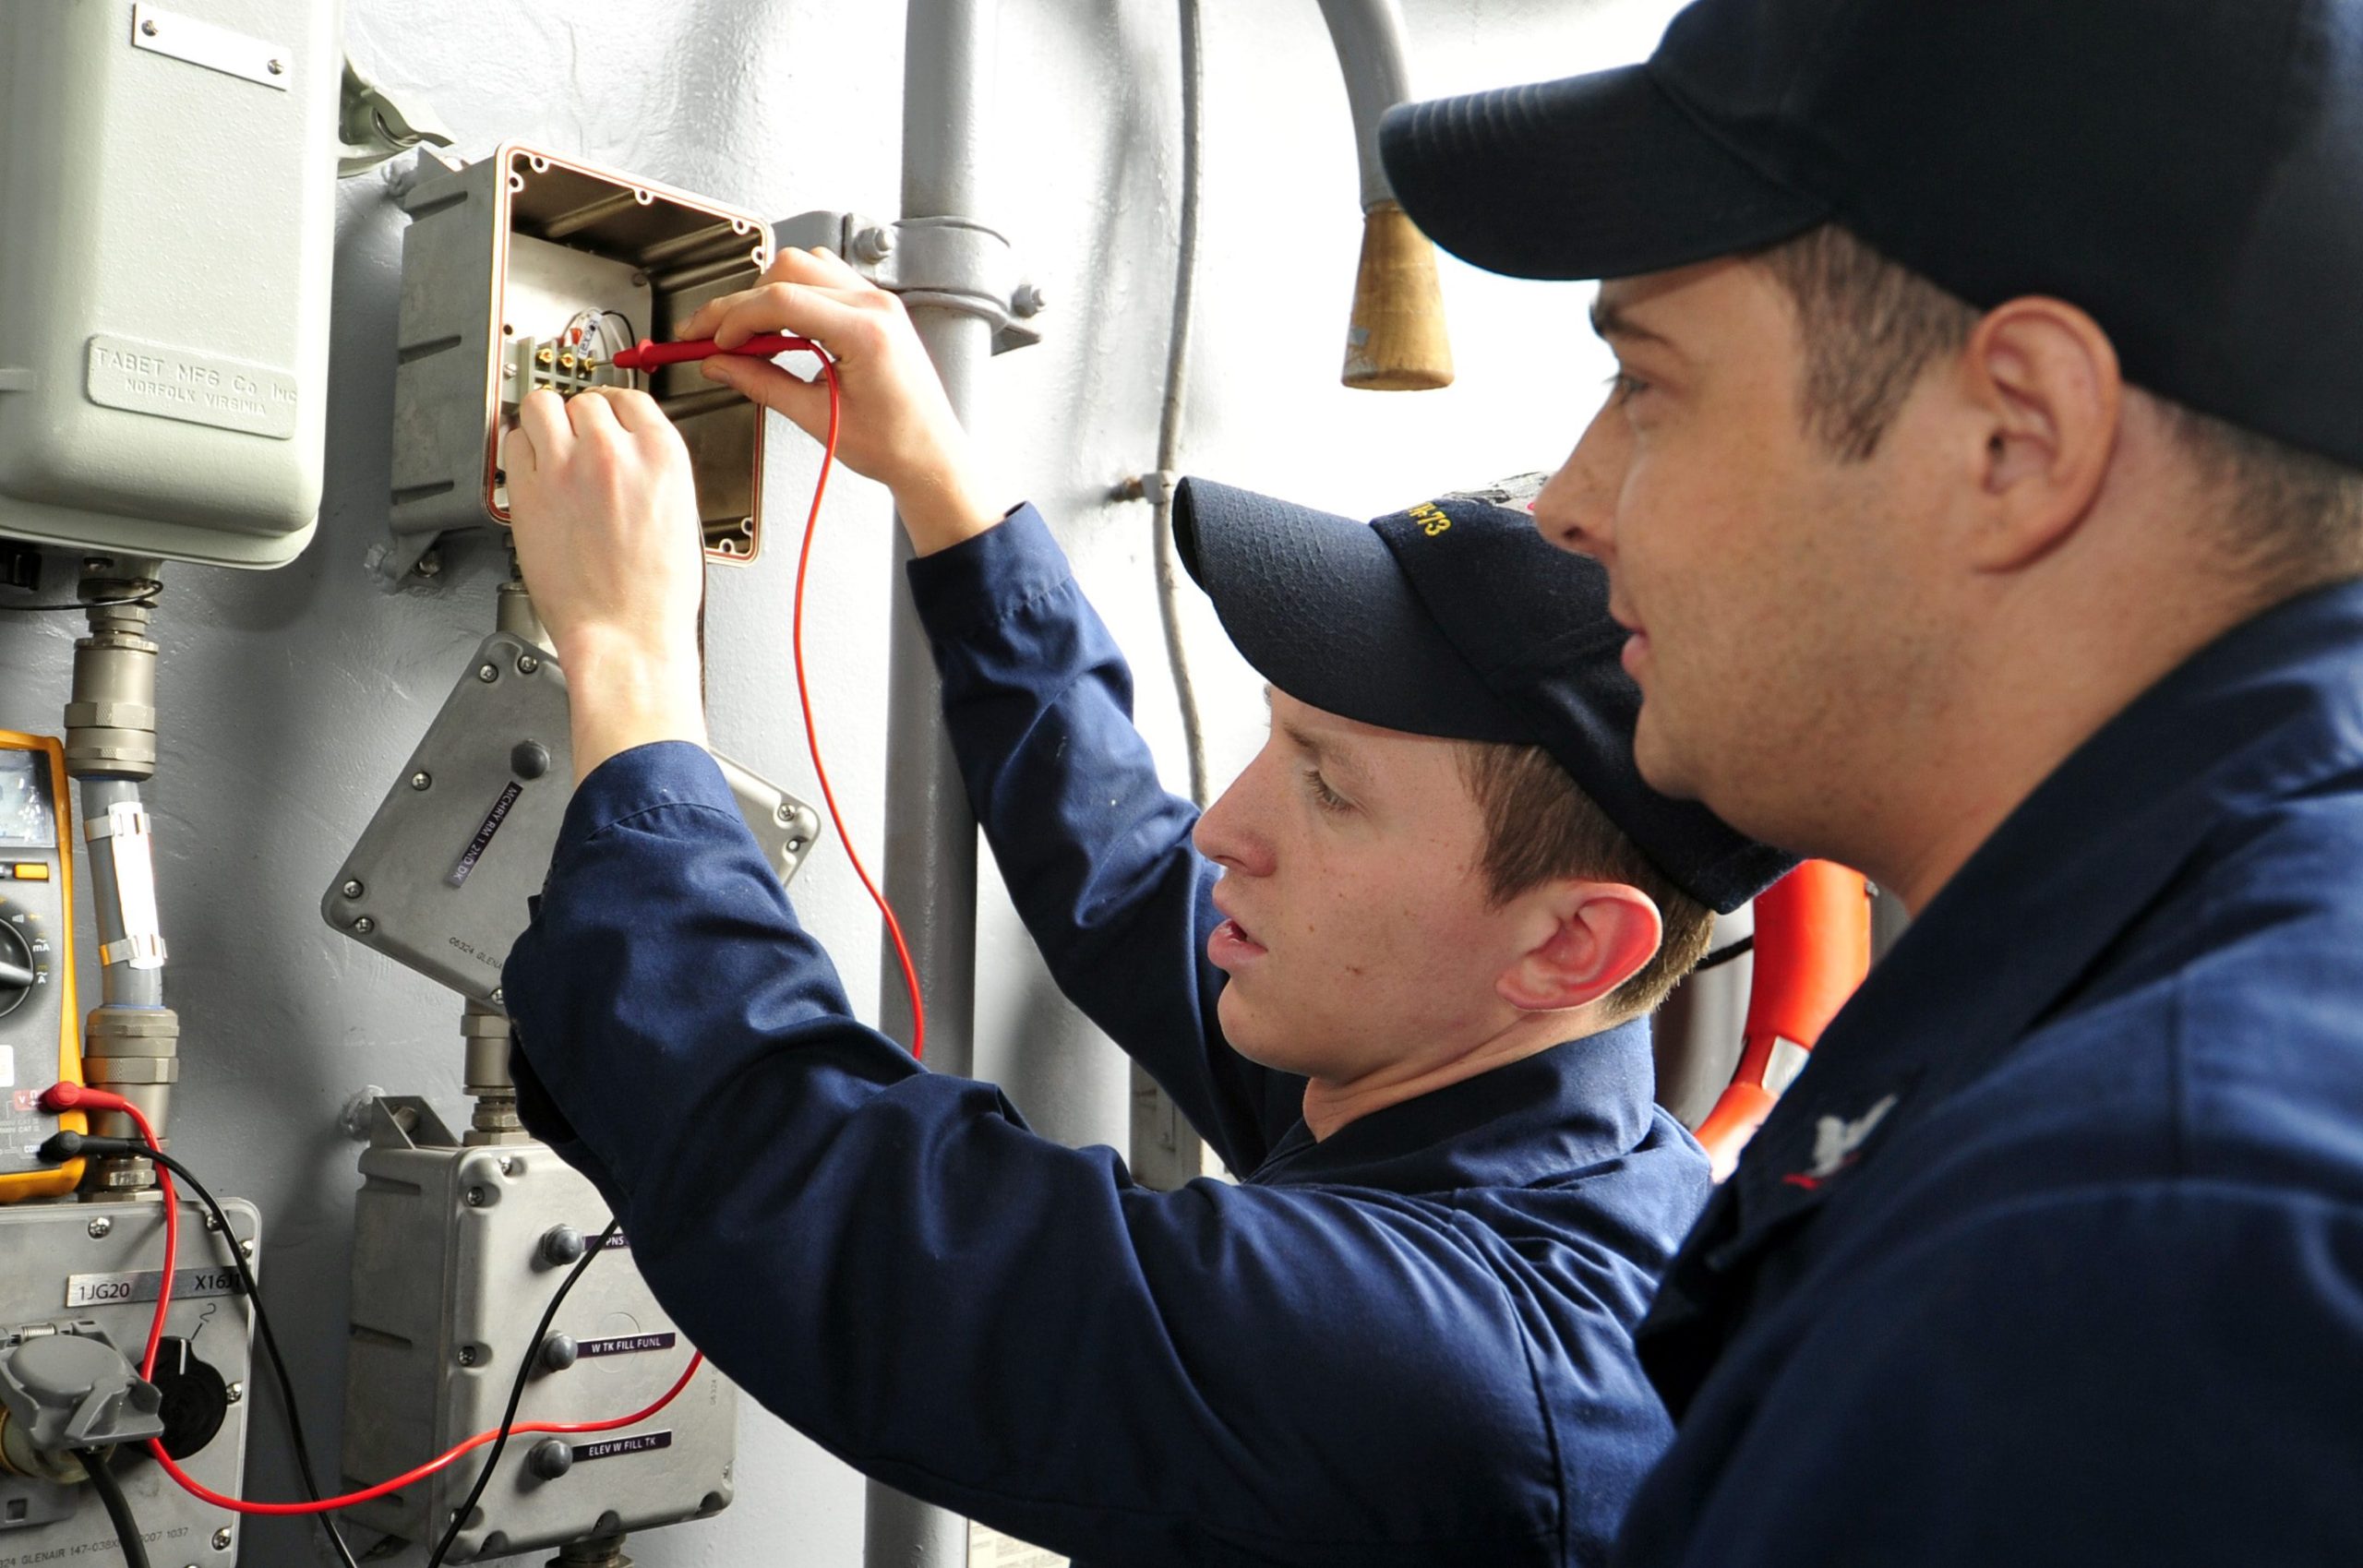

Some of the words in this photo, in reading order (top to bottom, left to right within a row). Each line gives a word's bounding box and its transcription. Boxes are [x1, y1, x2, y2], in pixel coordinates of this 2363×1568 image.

[96, 347, 164, 377] TABET
[177, 363, 221, 386] MFG
[126, 378, 196, 402] NORFOLK
[205, 392, 267, 414] VIRGINIA
[492, 786, 518, 821] MCHRY
[481, 820, 496, 837] RM
[463, 844, 481, 866] 2ND
[453, 865, 468, 880] DK
[32, 942, 51, 952] mA
[476, 952, 503, 969] GLENA
[37, 975, 46, 984] A
[78, 1283, 130, 1300] 1JG20
[591, 1344, 601, 1354] W
[603, 1342, 614, 1352] TK
[616, 1340, 635, 1350] FILL
[637, 1337, 662, 1348] FUNL
[589, 1443, 611, 1456] ELEV
[613, 1442, 622, 1453] W
[624, 1440, 642, 1451] FILL
[644, 1437, 656, 1446] TK
[21, 1548, 66, 1565] GLENAIR
[70, 1537, 120, 1557] 147-038X
